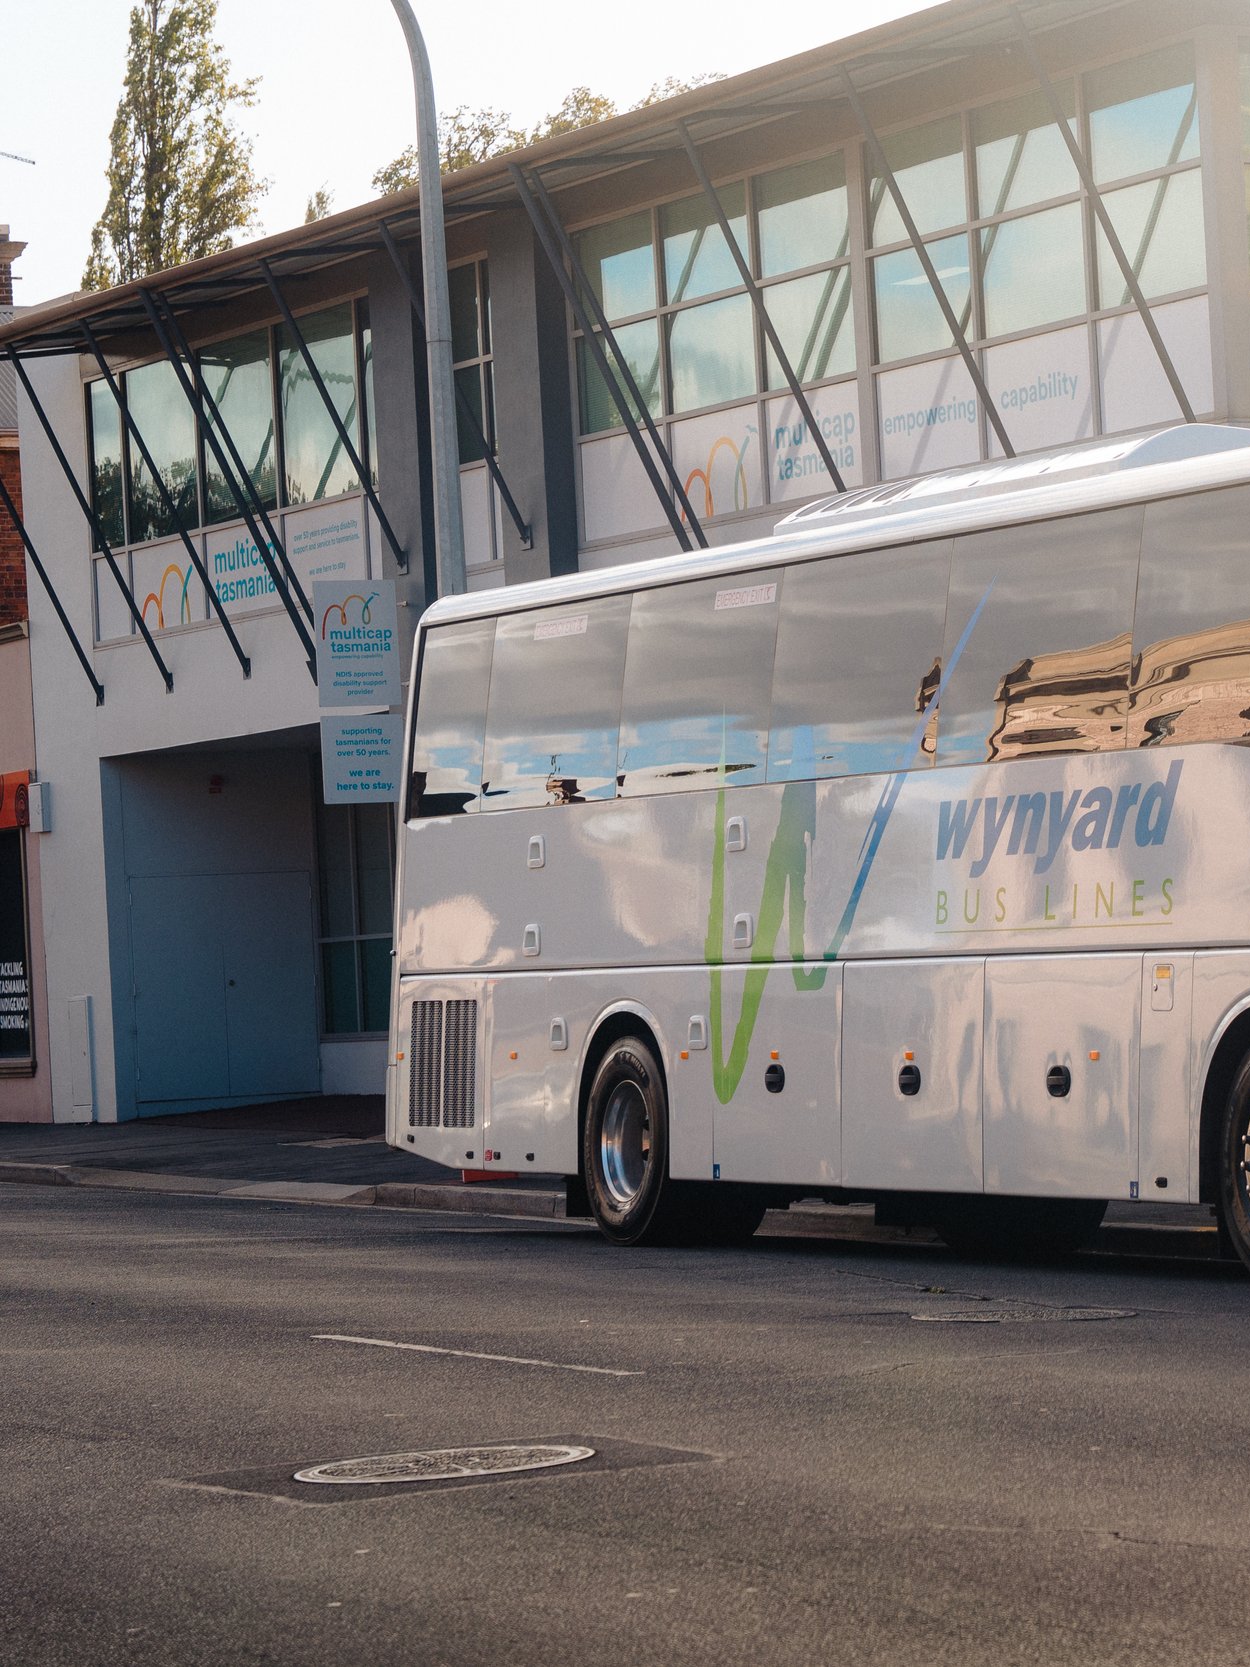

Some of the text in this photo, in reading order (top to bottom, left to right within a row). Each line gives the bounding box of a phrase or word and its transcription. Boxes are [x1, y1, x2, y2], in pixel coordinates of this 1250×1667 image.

[884, 372, 1078, 435] empowering capability
[775, 409, 855, 449] mulicap
[309, 530, 320, 540] years
[320, 524, 339, 535] providing
[339, 519, 357, 530] disability
[323, 565, 332, 573] here
[338, 562, 346, 570] stay
[215, 567, 276, 604] tasmania
[330, 626, 392, 642] multicap
[330, 639, 391, 652] tasmania
[353, 670, 384, 678] approved
[347, 688, 374, 696] provider
[341, 727, 383, 736] supporting
[335, 737, 391, 746] tasmanians for
[355, 748, 366, 756] 50
[368, 749, 391, 757] years.
[349, 769, 381, 777] we are
[336, 781, 394, 791] here to stay.
[936, 759, 1184, 878] wynyard
[935, 878, 1173, 925] BUS LINES
